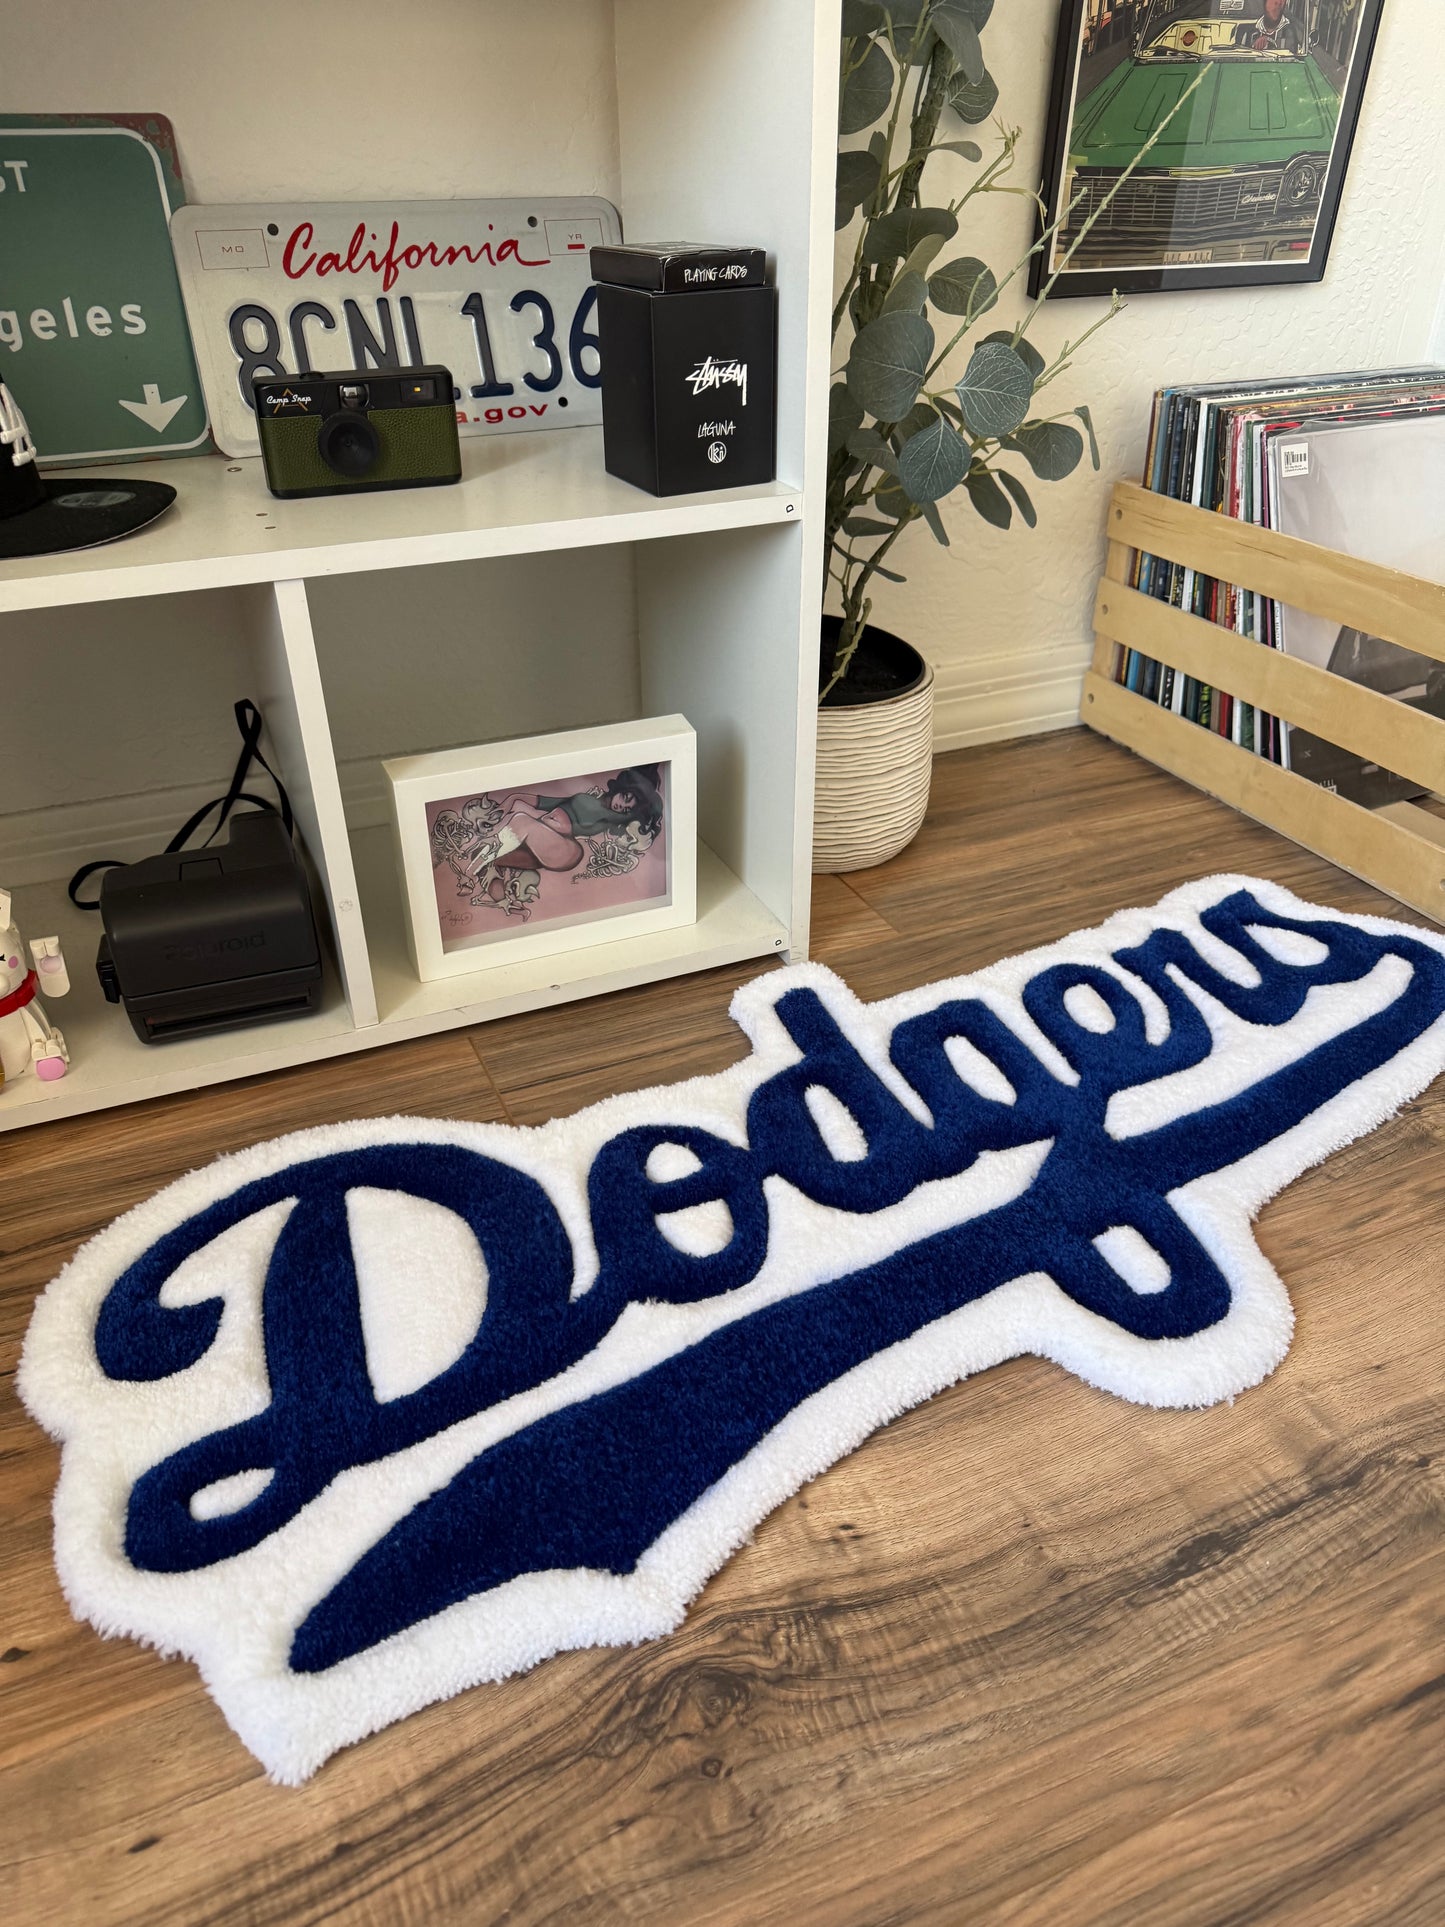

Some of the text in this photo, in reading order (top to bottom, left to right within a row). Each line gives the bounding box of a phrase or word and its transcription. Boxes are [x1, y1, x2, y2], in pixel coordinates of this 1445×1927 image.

[568, 233, 583, 241] YR
[221, 245, 245, 254] MO
[282, 221, 551, 291] California
[684, 265, 748, 284] PLAYING CARDS
[266, 394, 312, 406] Camp Snap
[697, 419, 737, 438] LAGUNA
[95, 889, 1445, 1674] Dodgers
